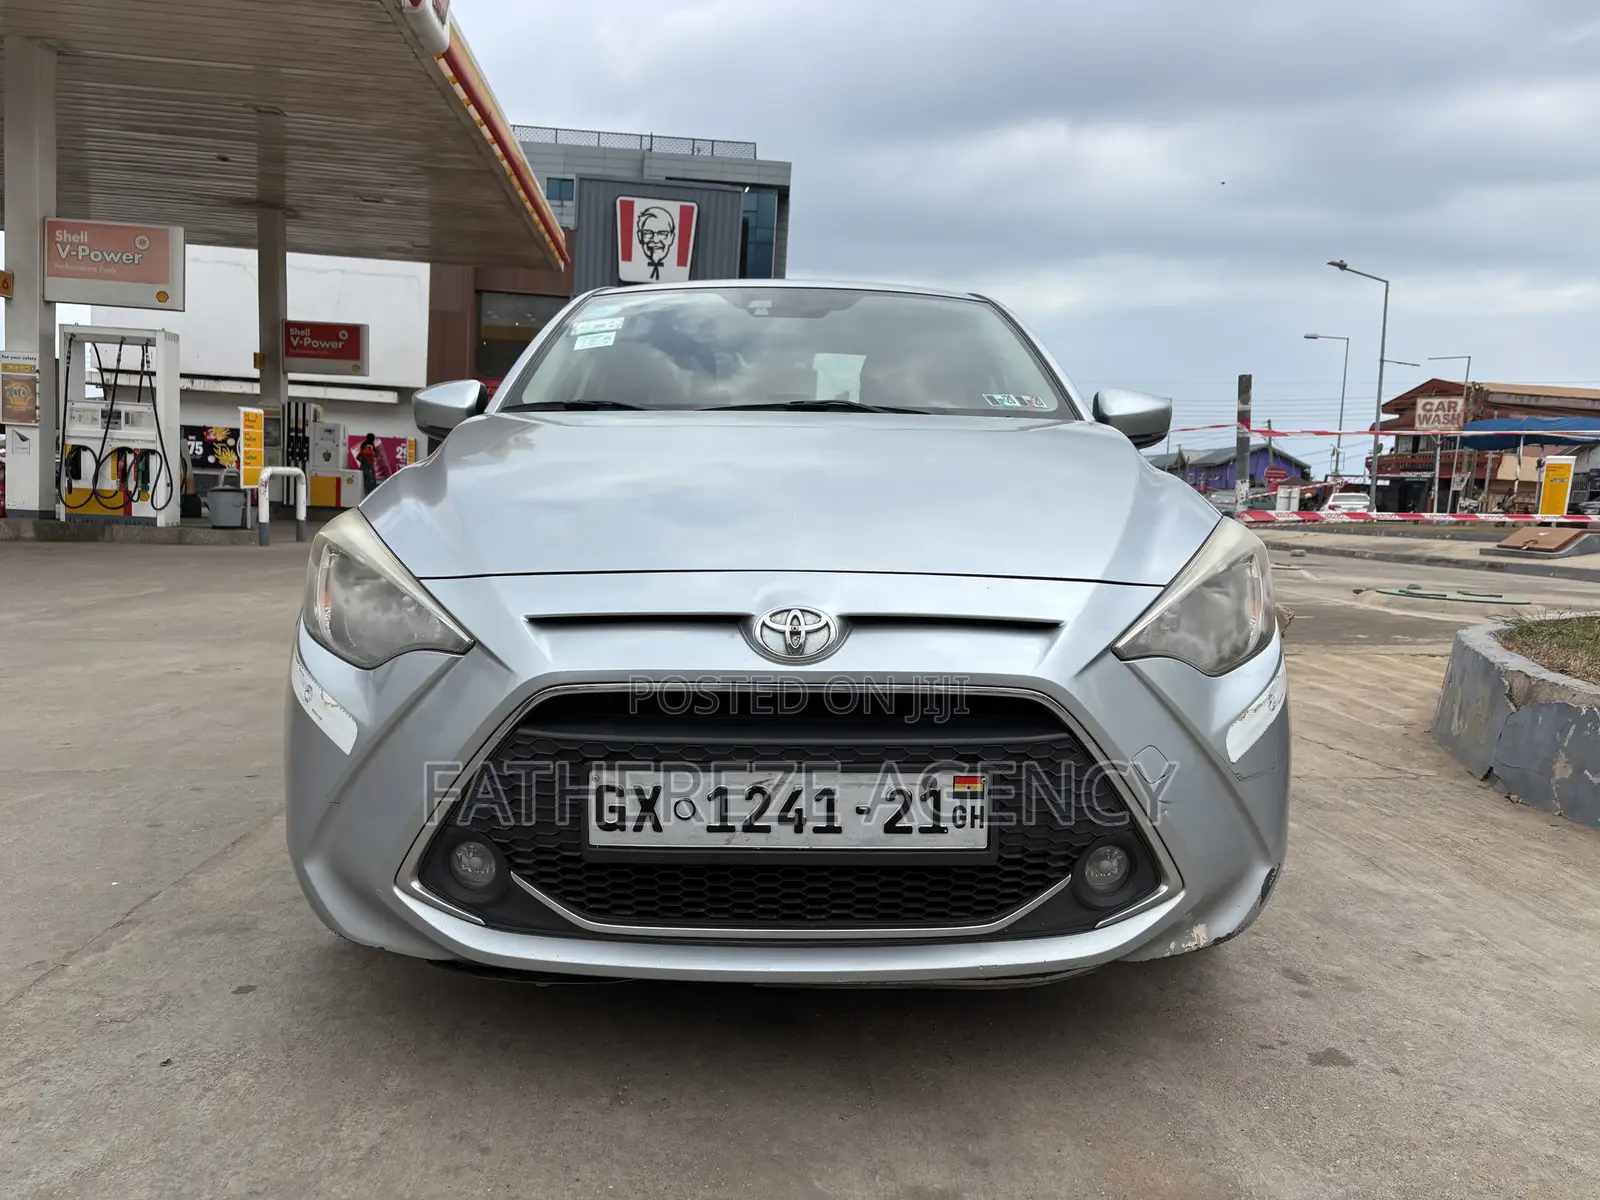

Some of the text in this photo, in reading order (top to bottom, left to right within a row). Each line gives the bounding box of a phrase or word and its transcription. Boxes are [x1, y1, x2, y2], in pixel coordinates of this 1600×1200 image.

[55, 230, 88, 243] Shell
[56, 243, 143, 265] V-Power
[289, 328, 311, 337] Shell
[289, 336, 345, 350] V-Power
[1422, 401, 1459, 413] CAR
[1417, 413, 1461, 426] WASH
[187, 440, 204, 455] 75
[595, 784, 663, 833] GX
[705, 785, 843, 834] 1241
[883, 785, 949, 834] 21
[952, 804, 985, 829] GH
